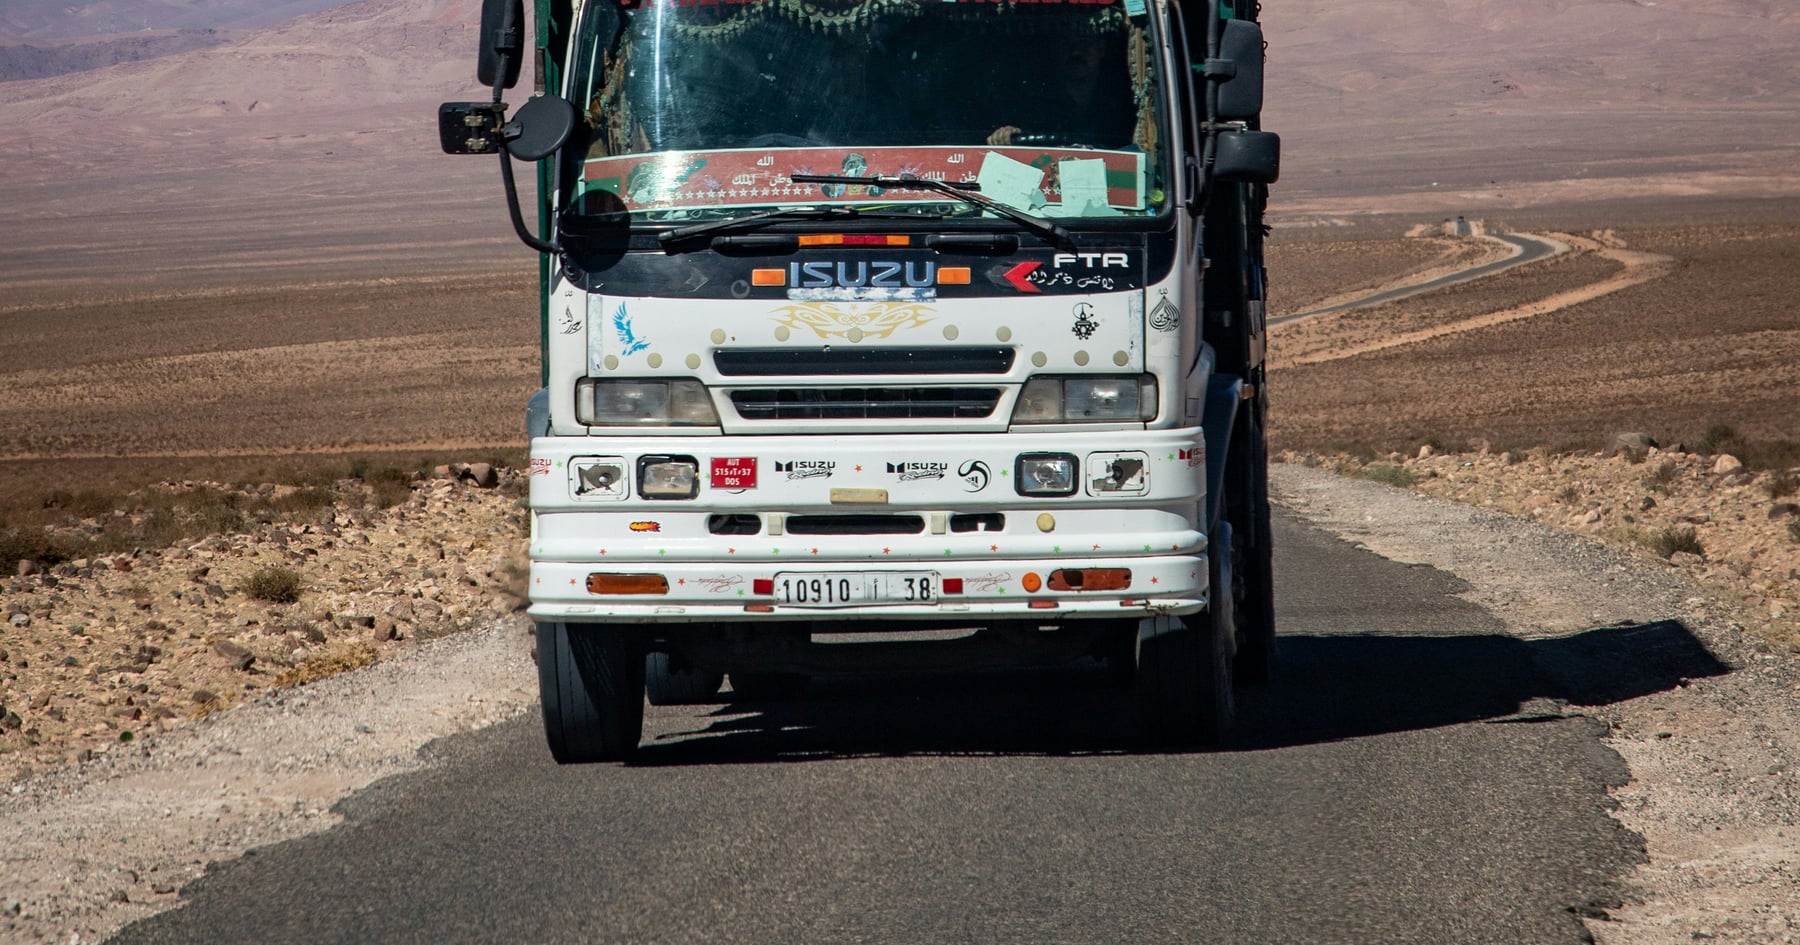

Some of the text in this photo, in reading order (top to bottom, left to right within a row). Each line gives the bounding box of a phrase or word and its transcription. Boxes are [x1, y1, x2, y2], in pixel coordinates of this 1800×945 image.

[756, 156, 774, 166] الله
[946, 153, 965, 164] الله
[731, 173, 756, 186] الملك
[1053, 252, 1129, 269] FTR
[790, 261, 935, 287] ISUZU
[726, 458, 740, 466] AUT
[794, 461, 836, 469] ISUZU
[906, 462, 948, 471] ISUZU
[724, 477, 740, 486] DOS
[782, 578, 850, 604] 10910
[903, 577, 931, 601] 38
